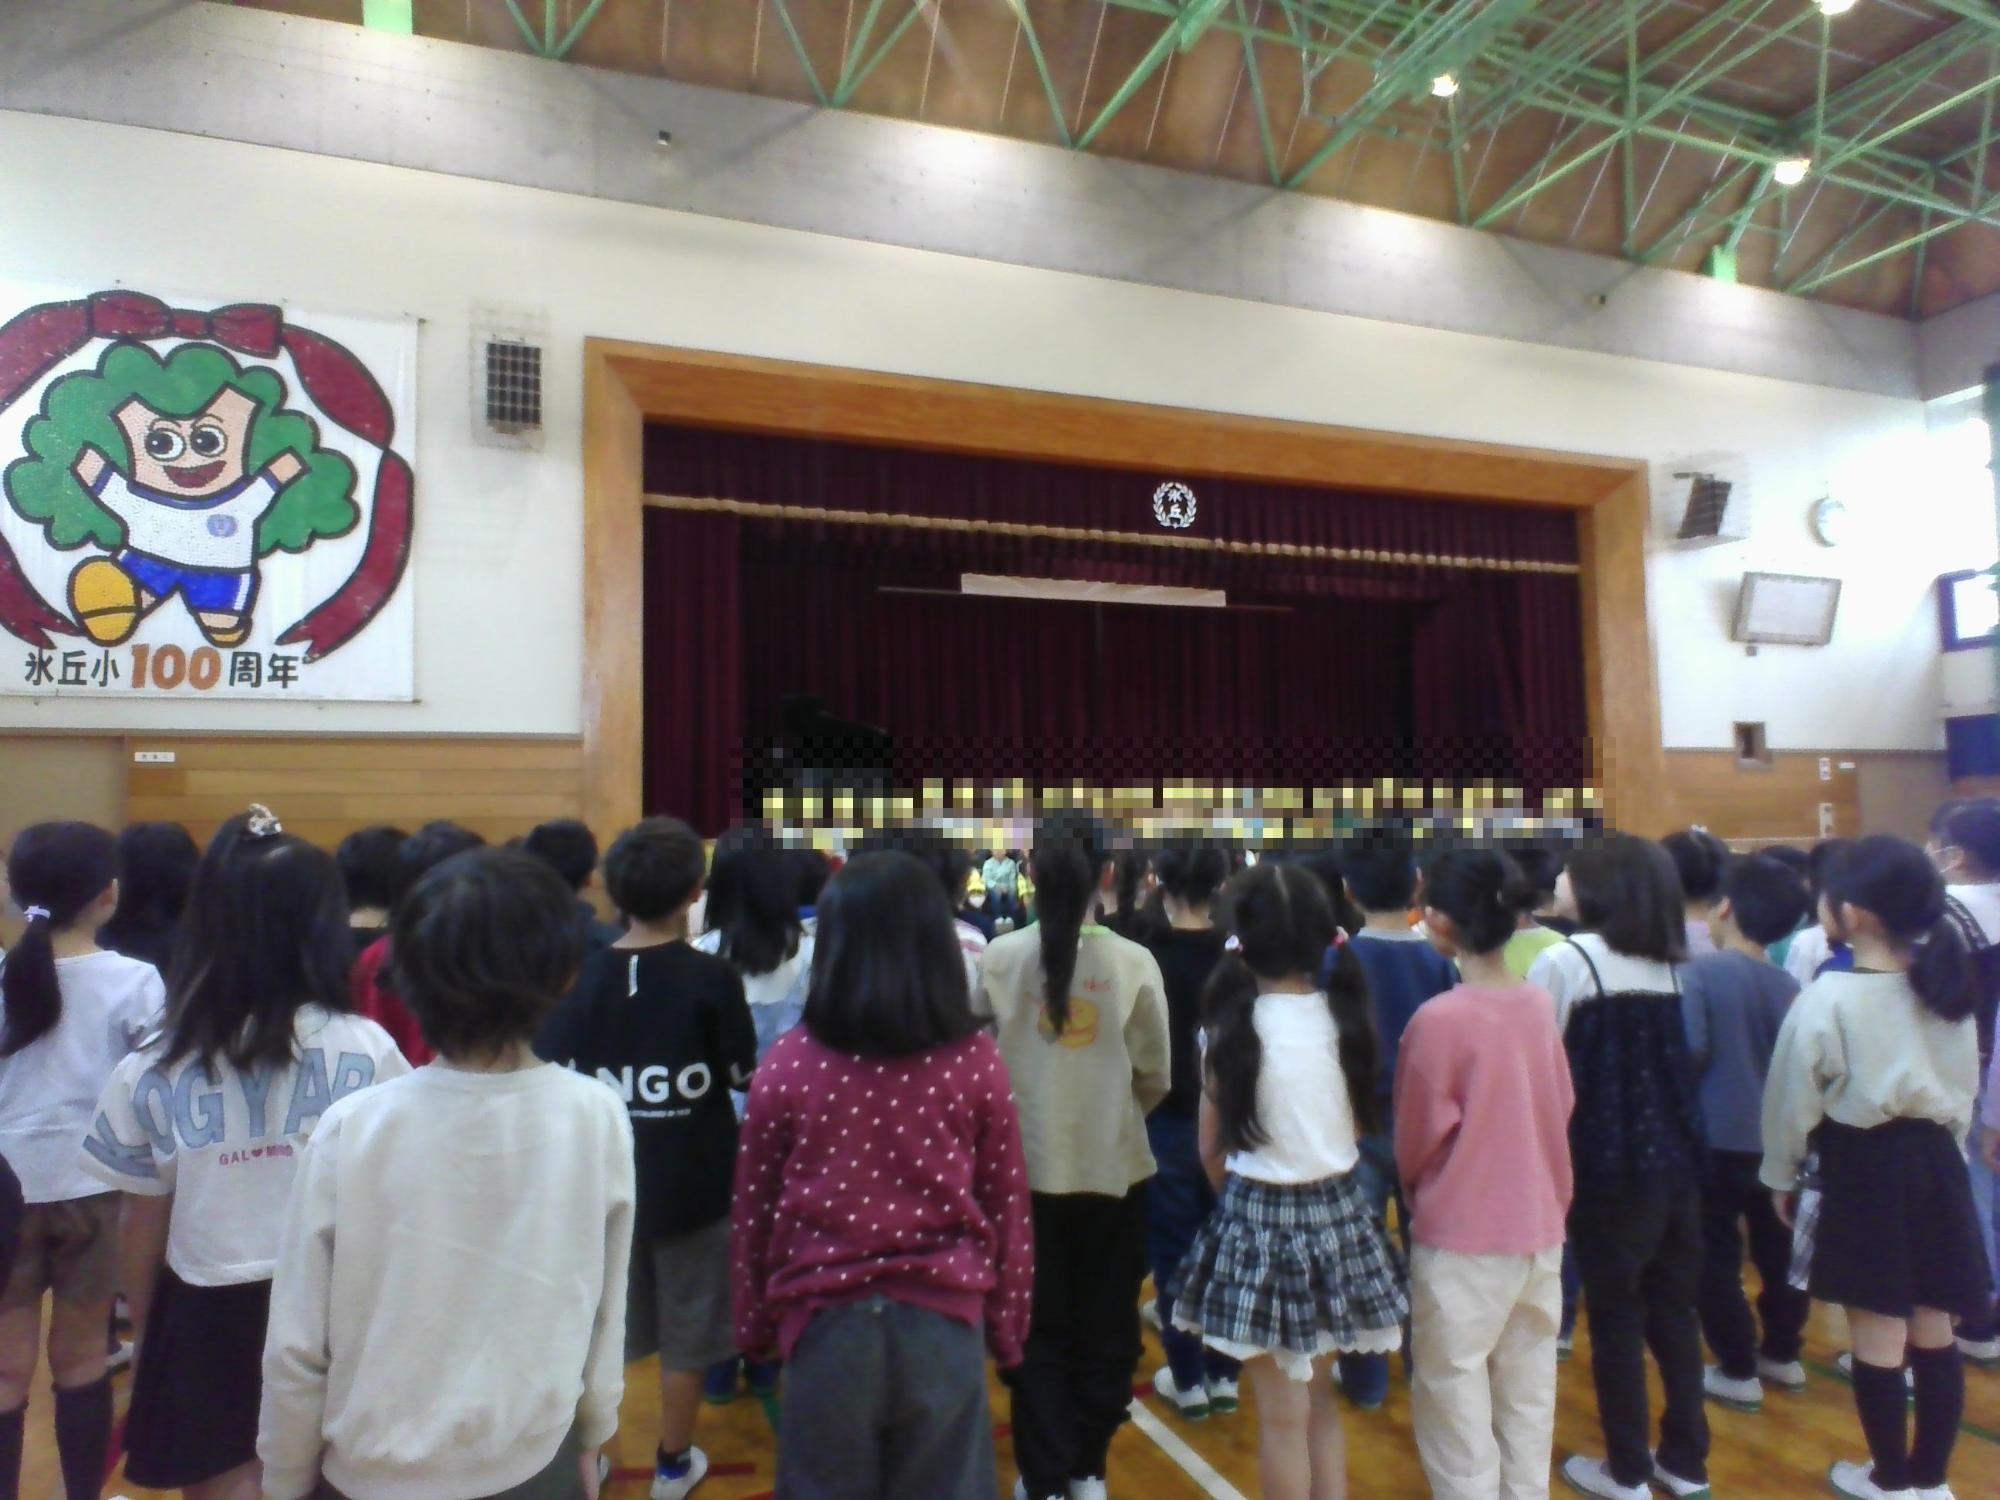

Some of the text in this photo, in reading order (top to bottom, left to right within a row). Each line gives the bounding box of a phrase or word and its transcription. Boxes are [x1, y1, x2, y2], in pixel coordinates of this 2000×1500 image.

[24, 644, 299, 690] 氷丘小100周年
